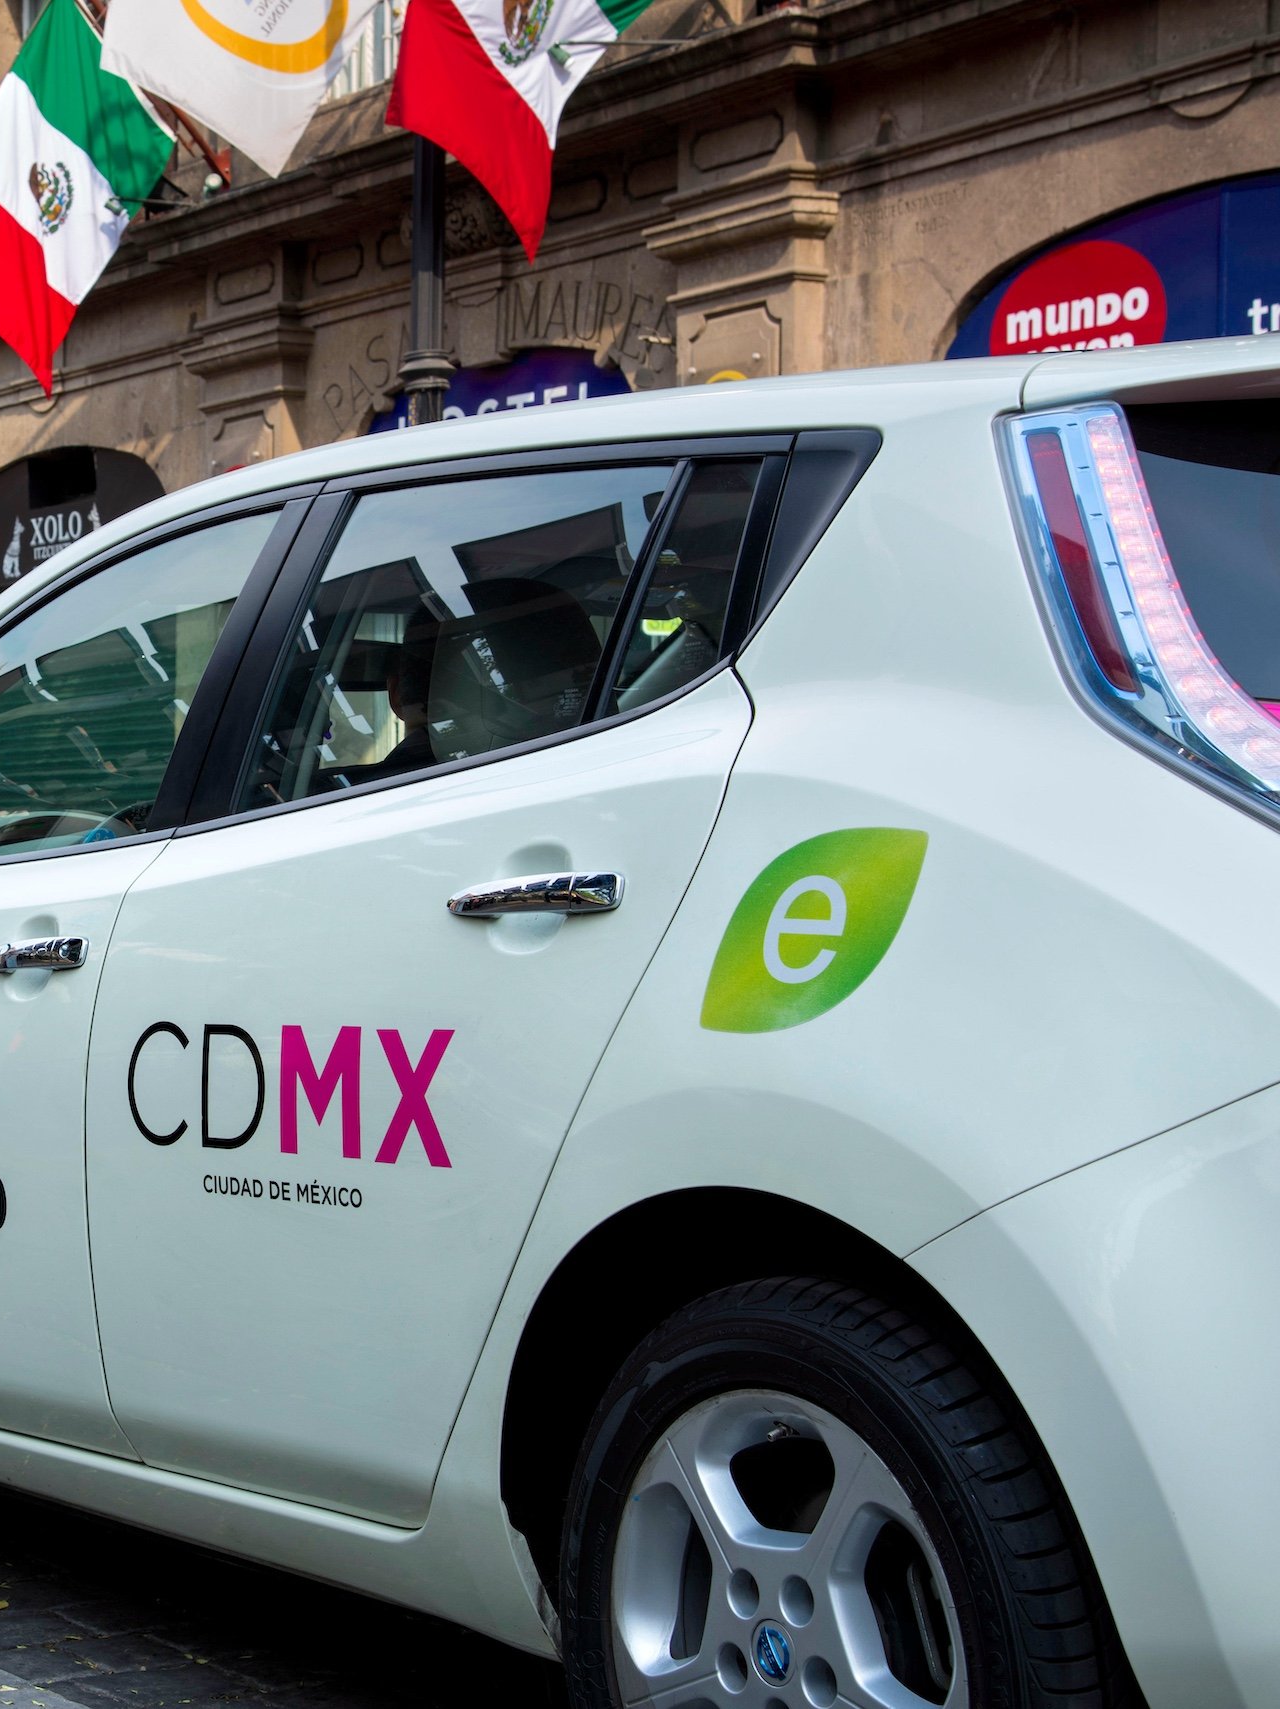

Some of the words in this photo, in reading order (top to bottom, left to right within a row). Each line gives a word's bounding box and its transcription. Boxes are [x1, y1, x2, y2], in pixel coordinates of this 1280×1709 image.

[29, 510, 82, 547] XOLO
[763, 874, 848, 985] e
[127, 1020, 455, 1169] CDMX
[203, 1174, 264, 1198] CIUDAD
[269, 1180, 291, 1201] DE
[296, 1179, 363, 1208] MÉXICO
